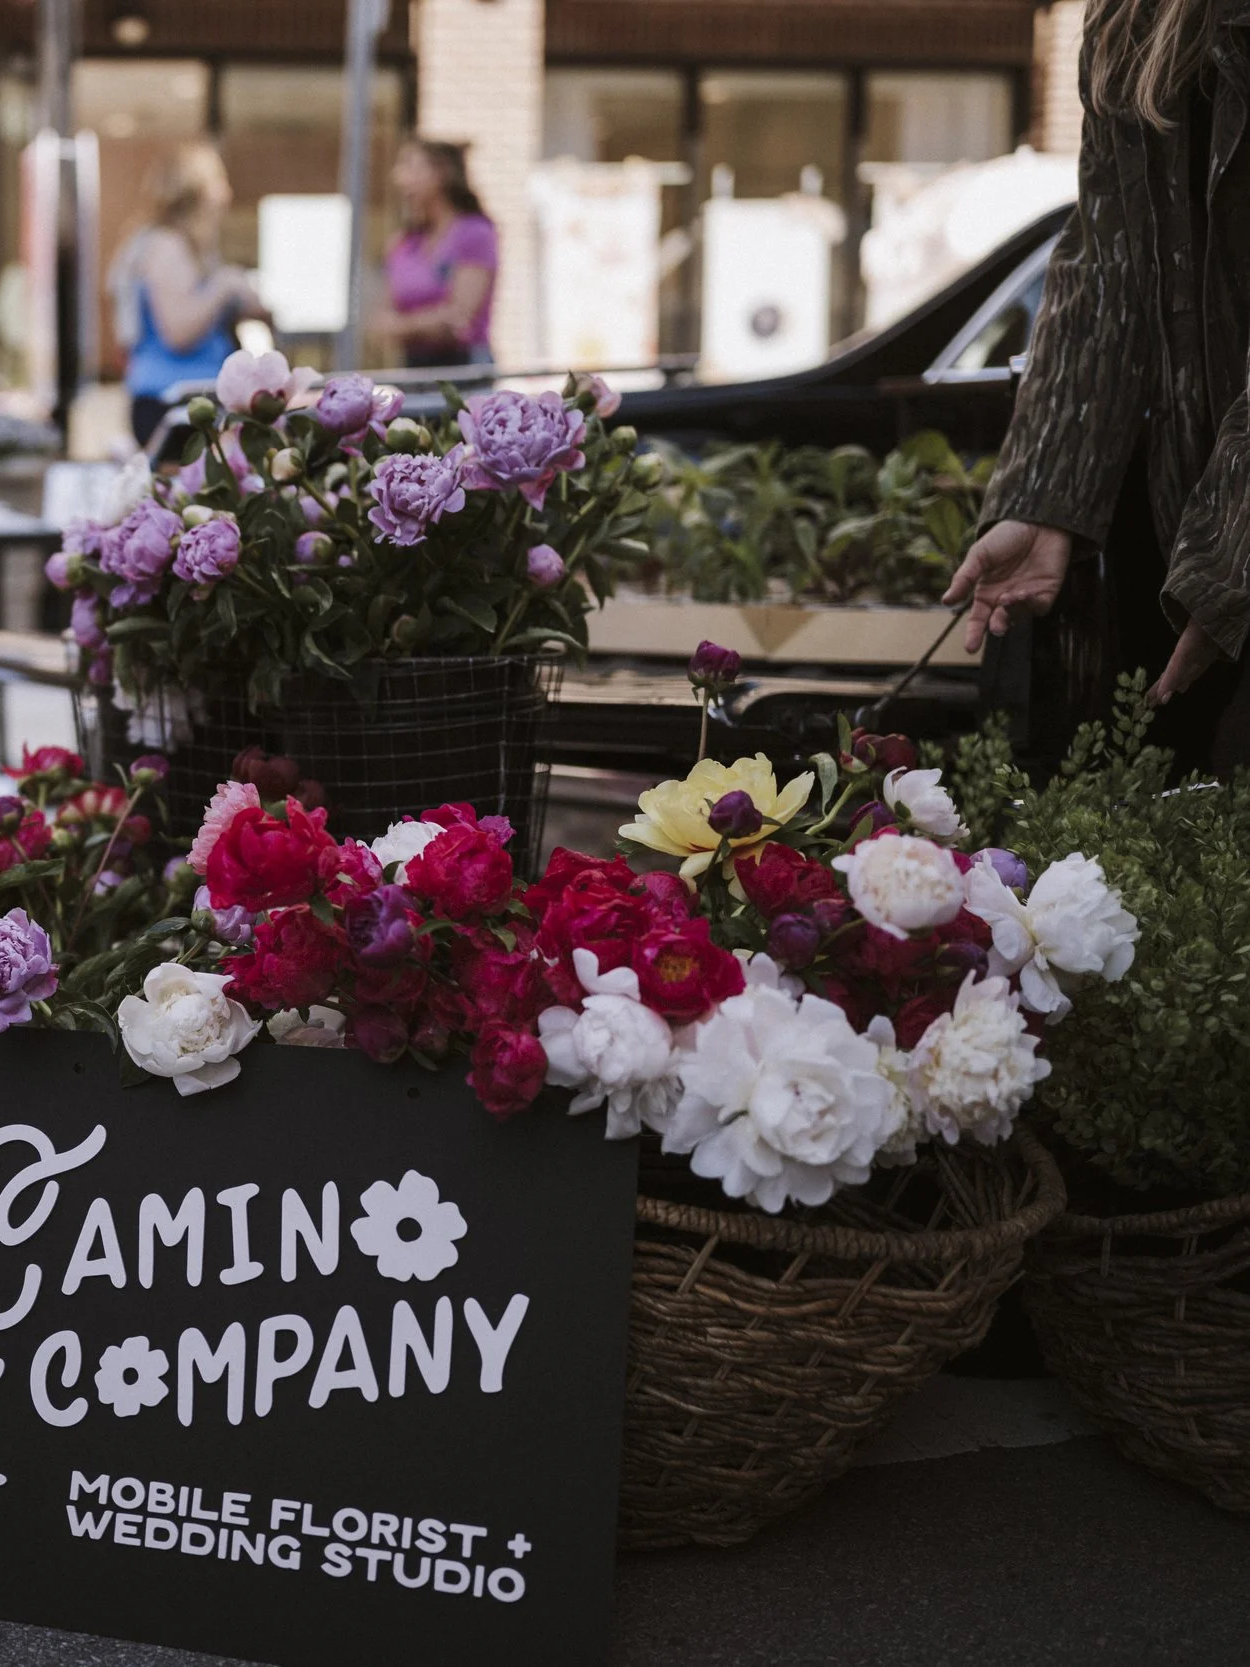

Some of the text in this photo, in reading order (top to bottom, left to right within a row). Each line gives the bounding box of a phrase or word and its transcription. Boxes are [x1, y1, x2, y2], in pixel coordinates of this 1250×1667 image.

[65, 1504, 526, 1603] WEDDING STUDIO
[69, 1470, 532, 1559] MOBILE FLORIST +
